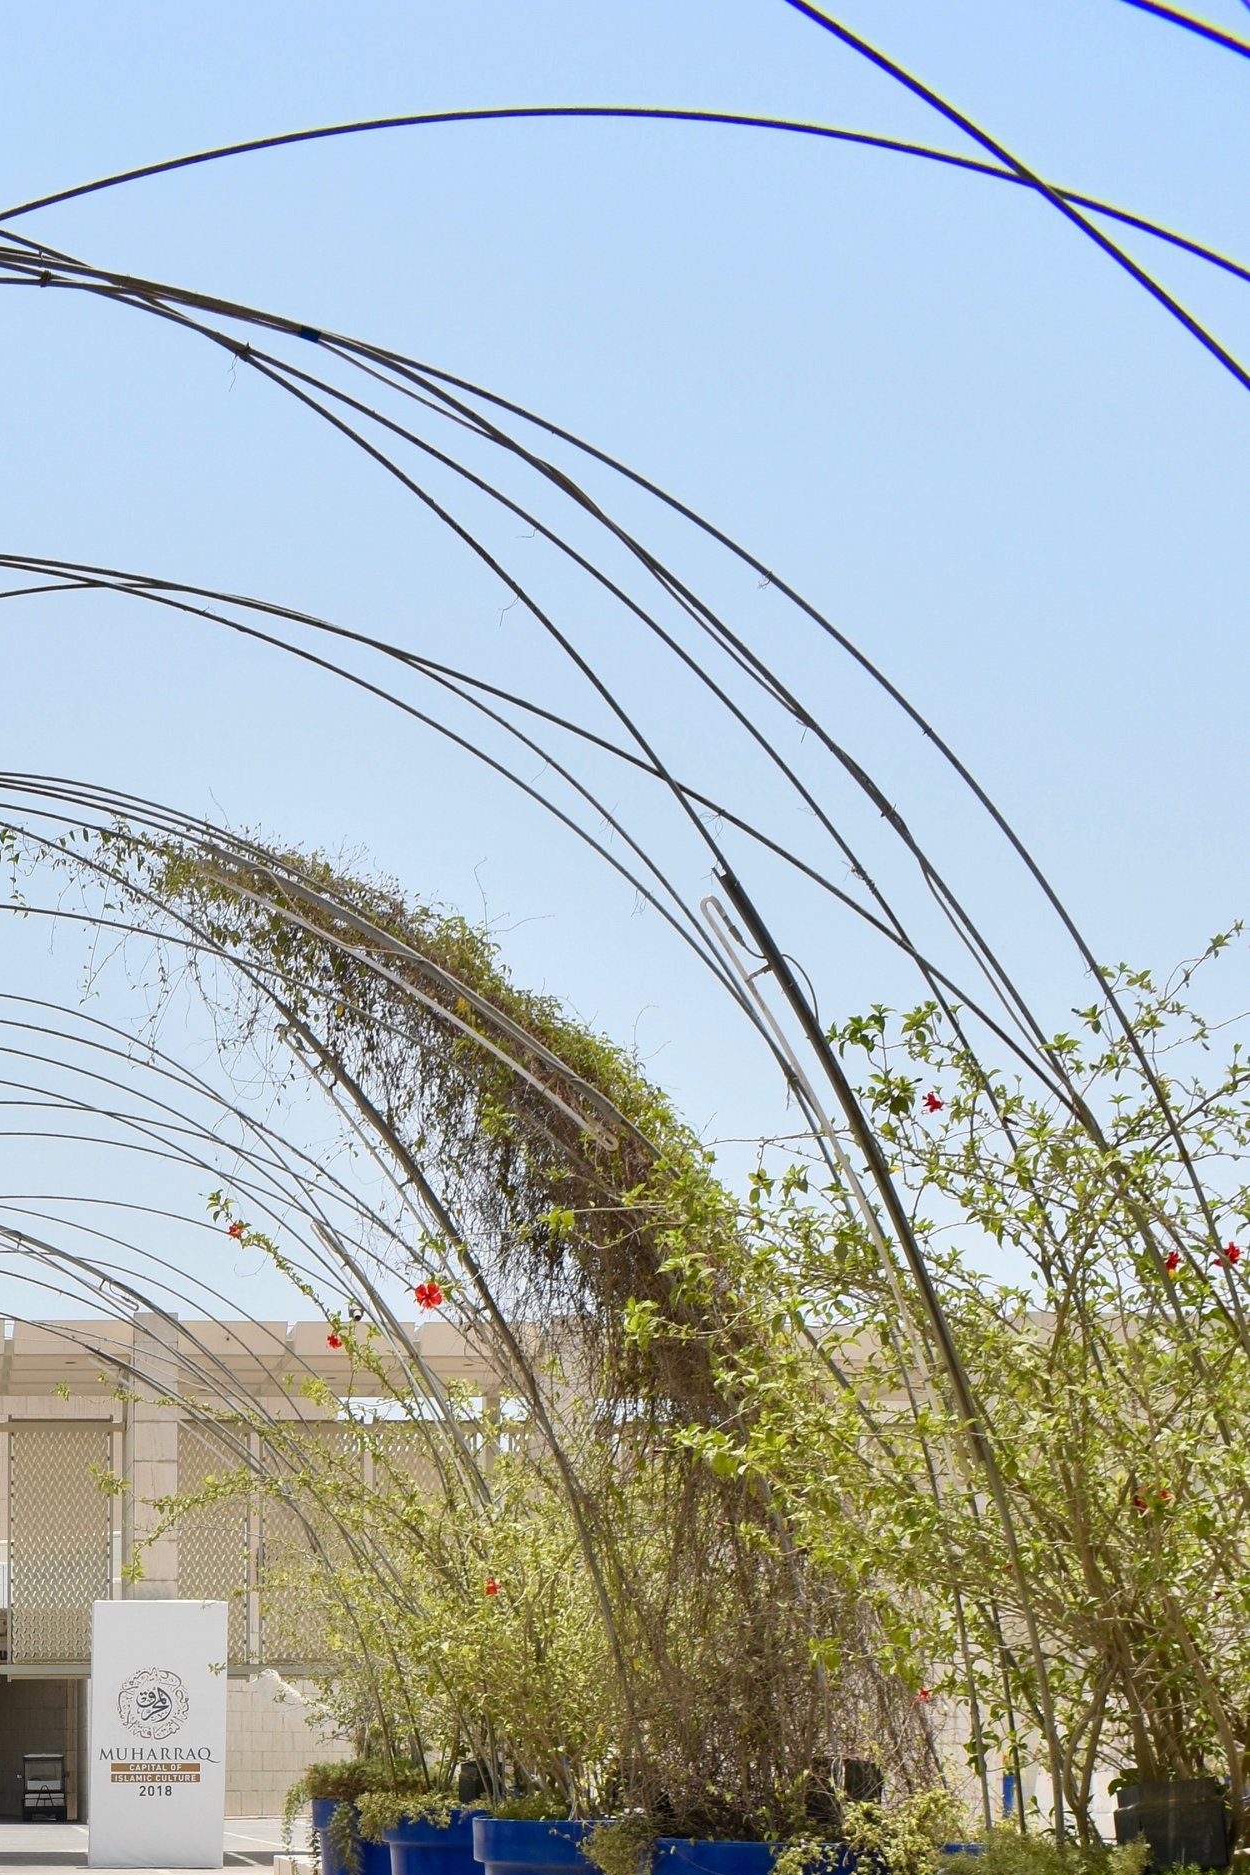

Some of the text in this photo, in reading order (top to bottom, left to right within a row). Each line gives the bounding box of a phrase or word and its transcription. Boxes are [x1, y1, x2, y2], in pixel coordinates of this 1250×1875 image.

[99, 1746, 221, 1764] MUHARRAQ
[129, 1763, 182, 1771] CAPITAL OF
[114, 1774, 197, 1782] ISLAMIC CULTURE
[139, 1785, 173, 1797] 2018
